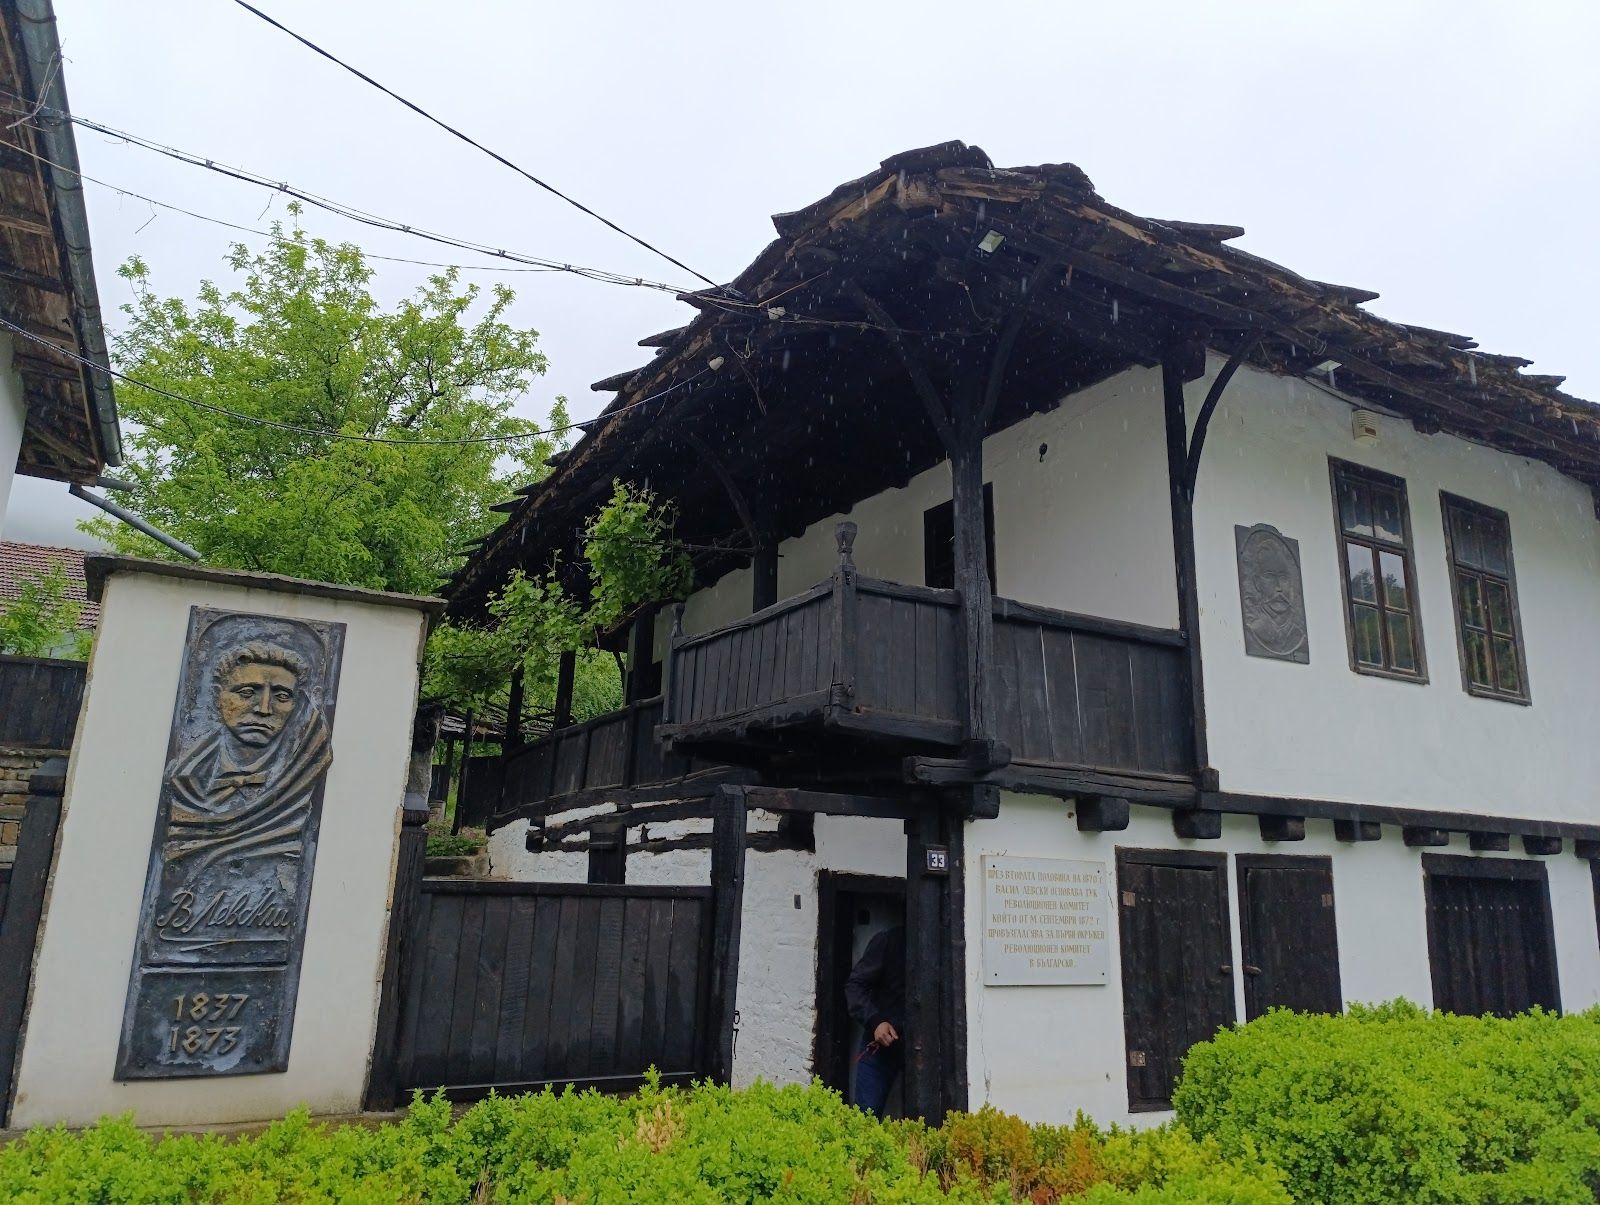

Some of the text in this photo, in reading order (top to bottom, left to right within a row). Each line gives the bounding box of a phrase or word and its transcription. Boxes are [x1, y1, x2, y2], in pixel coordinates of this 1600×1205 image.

[931, 853, 945, 868] 33
[1005, 871, 1036, 881] ВТОРАТА
[1038, 872, 1070, 883] ПОЛОВИНА
[1072, 874, 1081, 884] НА
[995, 884, 1098, 898] ВАСИЛ ЛЕВСКИ ОСНОВАВА ТУК
[1004, 899, 1089, 911] РЕВОЛЮЦИОНЕН КОМИТЕТ
[992, 911, 1017, 924] КОЙТО
[1019, 914, 1029, 924] ОТ
[1039, 914, 1077, 925] СЕПТЕМВРИ
[988, 928, 1105, 940] ПРОВЪЗГЛАСЯВА ЗА ПЪРВИ ОКРЪЖЕН
[1004, 944, 1091, 954] РЕВОЛЮЦИОНЕН КОМИТЕТ
[1029, 958, 1074, 969] В БЪЛГАРСКО
[175, 992, 249, 1022] 1837
[169, 1025, 242, 1055] 1873
